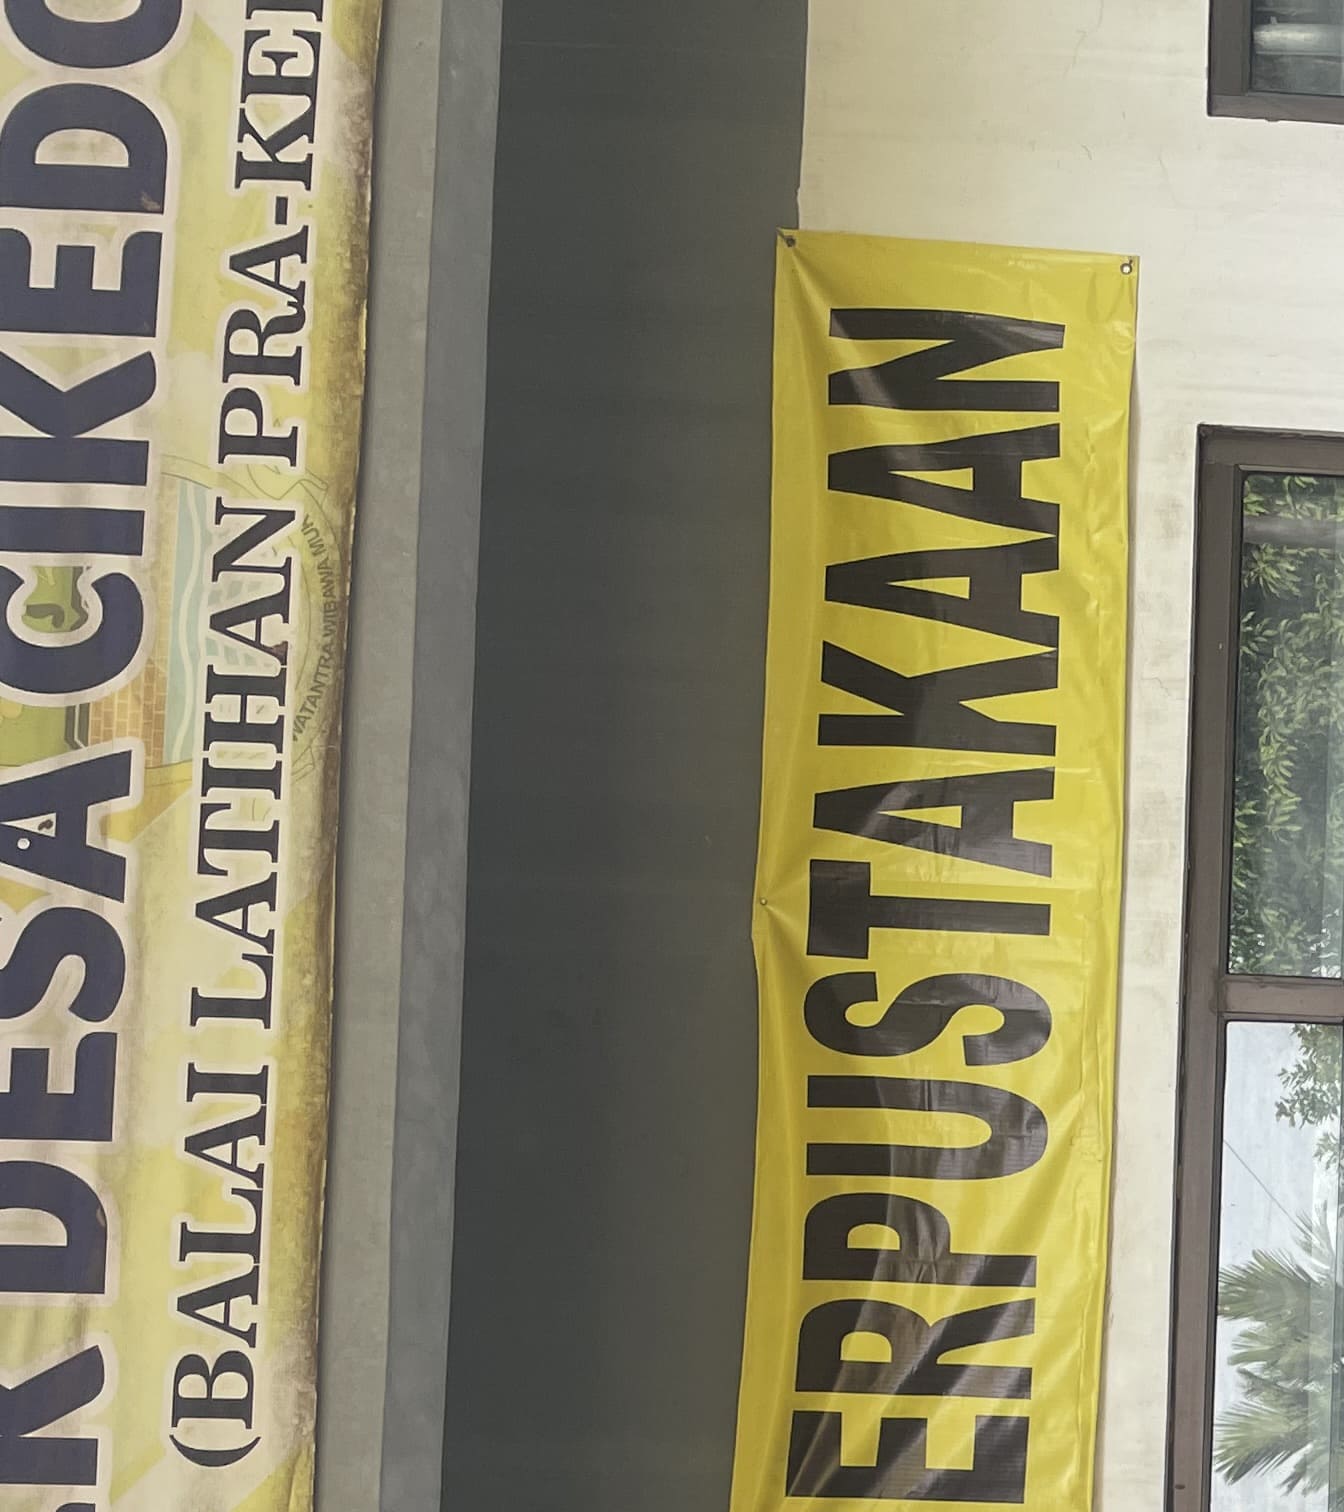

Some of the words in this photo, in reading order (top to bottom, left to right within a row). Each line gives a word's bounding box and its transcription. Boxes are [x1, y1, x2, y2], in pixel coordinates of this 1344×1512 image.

[189, 497, 296, 1029] LATIHAN
[317, 556, 338, 637] WIBAWA
[0, 749, 132, 1295] DESA
[168, 1062, 269, 1468] (BALAI
